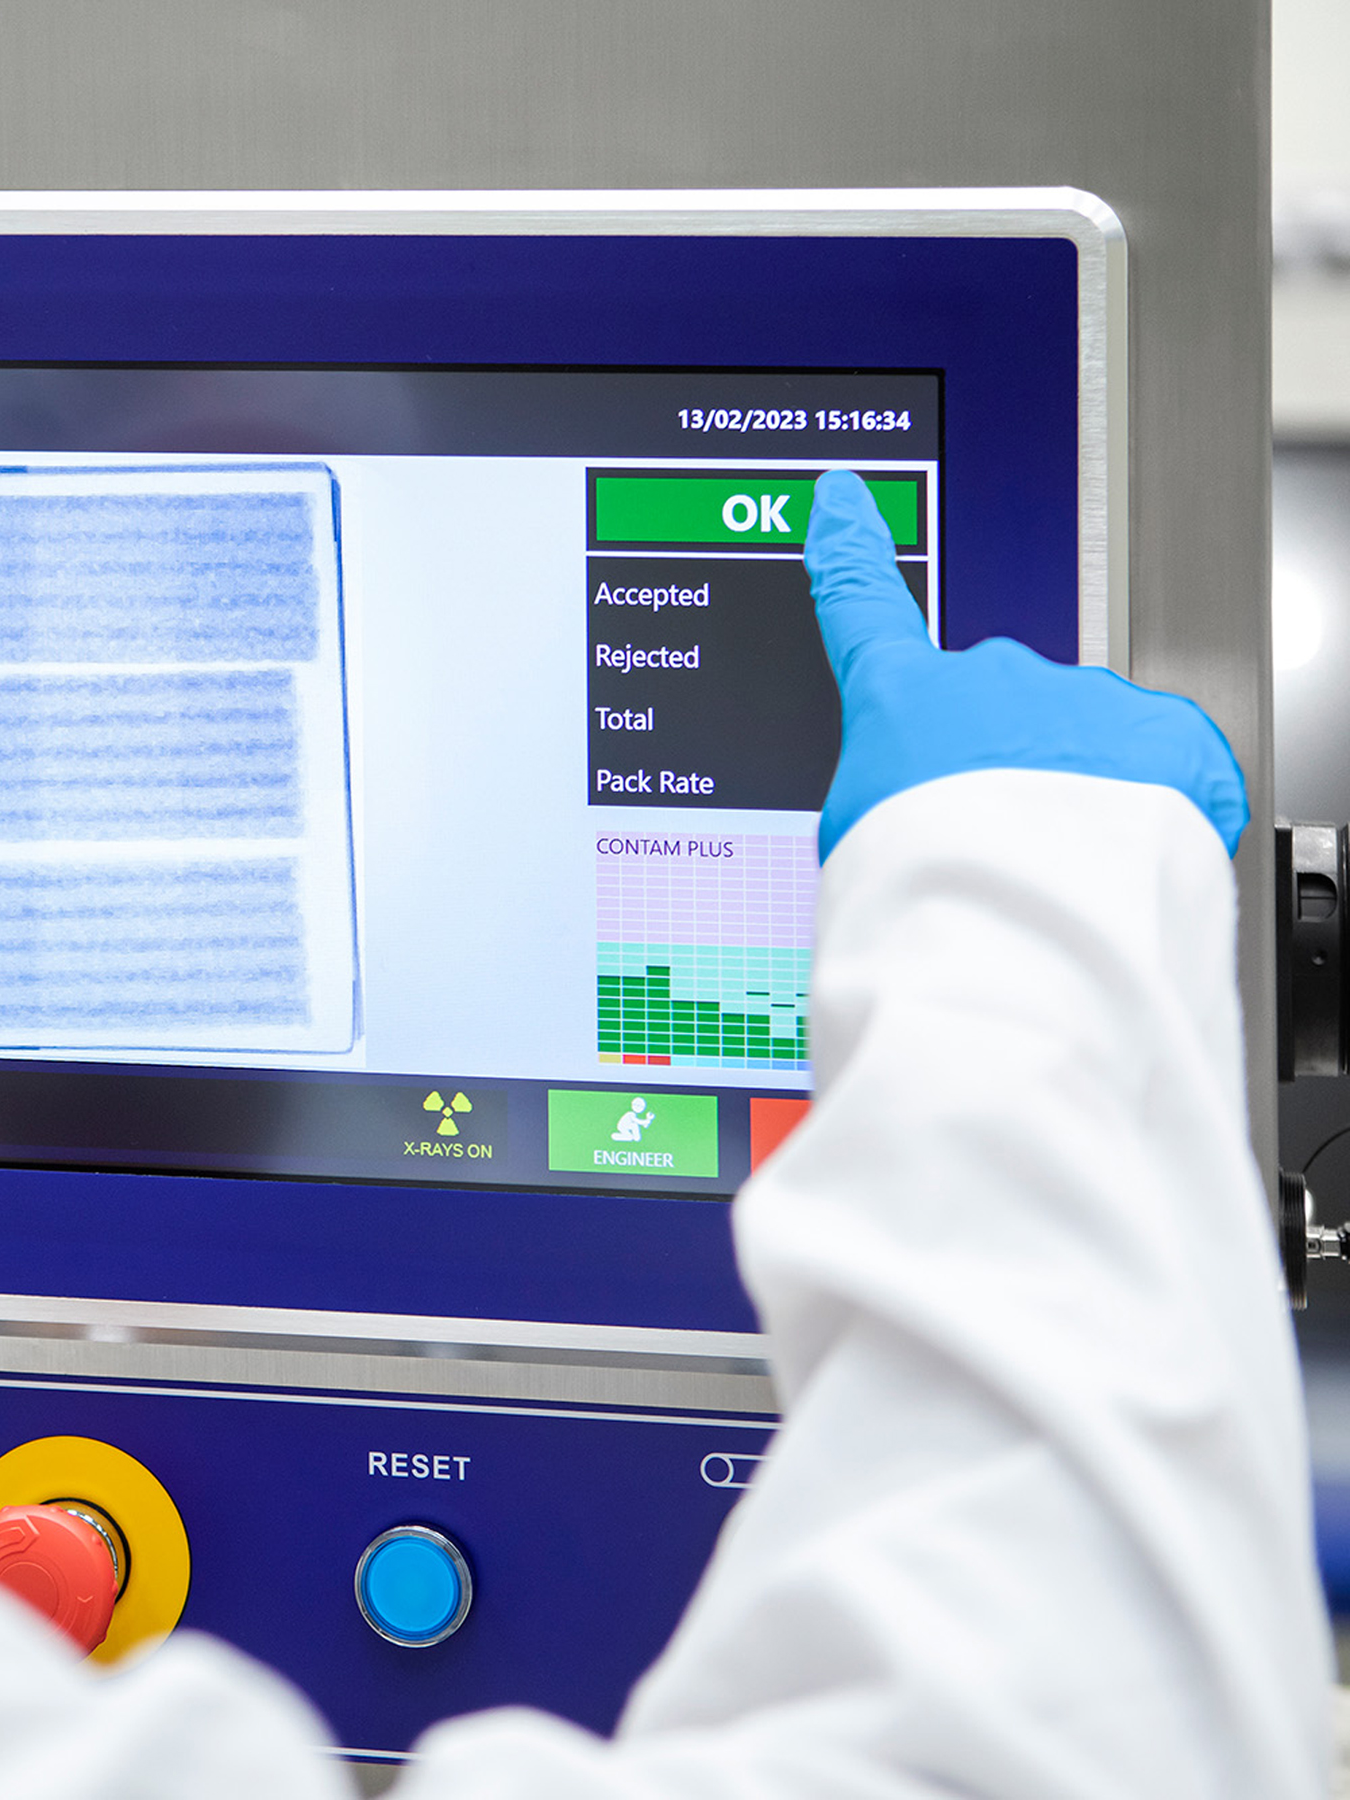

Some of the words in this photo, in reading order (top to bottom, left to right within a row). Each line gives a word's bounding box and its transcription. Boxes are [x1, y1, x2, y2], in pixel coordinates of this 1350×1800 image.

[677, 408, 807, 433] 13/02/2023
[815, 409, 911, 432] 15:16:34
[721, 494, 792, 533] OK
[594, 582, 710, 612] Accepted
[595, 643, 700, 674] Rejected
[594, 706, 654, 732] Total
[595, 769, 652, 793] Pack
[659, 771, 714, 795] Rate
[596, 837, 681, 856] CONTAM
[687, 840, 734, 858] PLUS
[403, 1141, 464, 1158] X-RAYS
[467, 1144, 493, 1159] ON
[593, 1149, 674, 1169] ENGINEER
[368, 1451, 471, 1481] RESET
